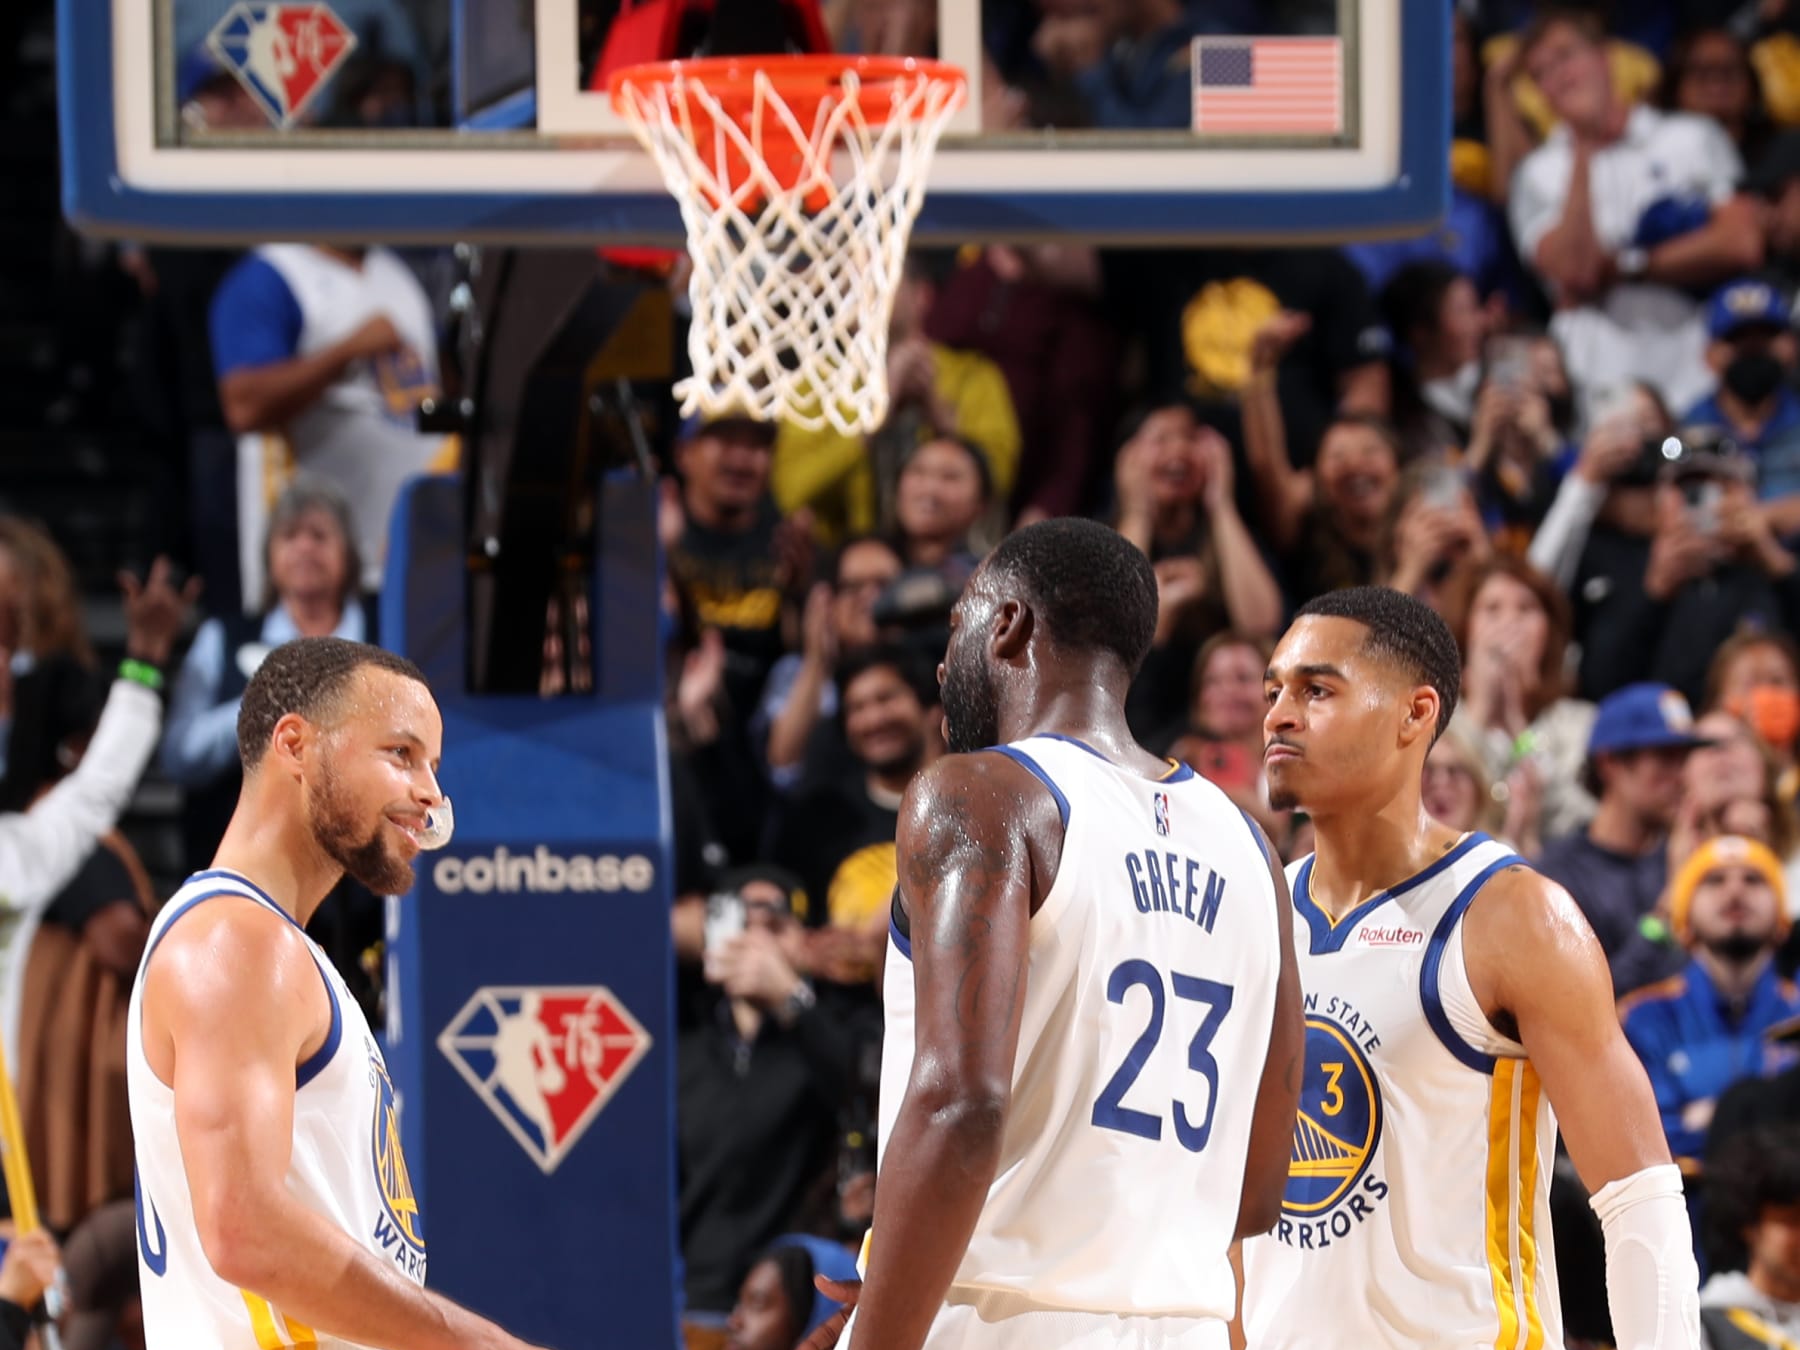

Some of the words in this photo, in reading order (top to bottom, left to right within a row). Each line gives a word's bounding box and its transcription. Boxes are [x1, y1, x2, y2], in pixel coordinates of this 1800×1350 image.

[433, 844, 654, 894] coinbase
[1125, 849, 1226, 935] GREEN
[1359, 925, 1424, 945] Rakuten
[1091, 958, 1234, 1152] 23
[1327, 996, 1381, 1055] STATE
[1320, 1062, 1344, 1116] 3
[1270, 1173, 1389, 1250] RRIORS
